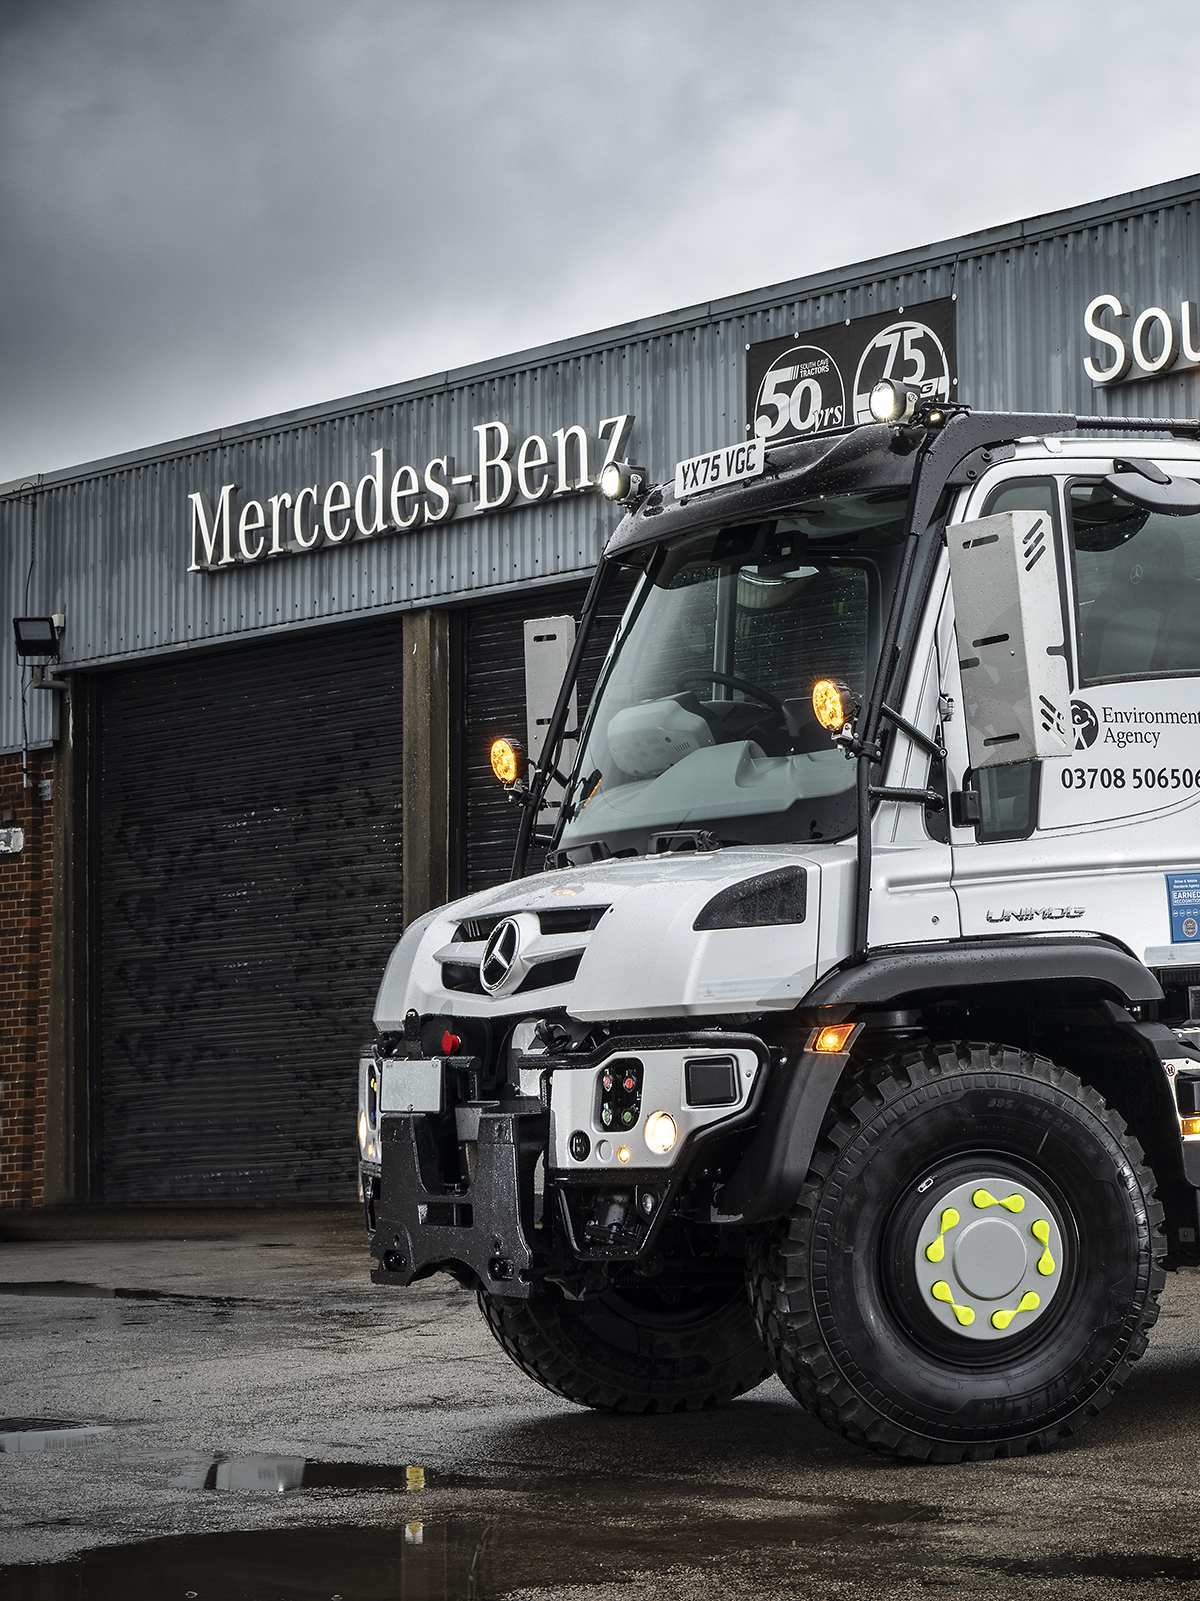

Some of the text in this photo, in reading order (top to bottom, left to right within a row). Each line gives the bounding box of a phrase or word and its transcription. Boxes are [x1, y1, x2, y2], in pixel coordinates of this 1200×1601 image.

[800, 357, 829, 370] SOUTH CAVE
[875, 328, 926, 385] 75
[800, 365, 830, 378] TRACTORS
[755, 366, 843, 438] 50 yrs
[682, 444, 756, 490] YX75 VGC
[187, 414, 633, 572] Mercedes-Benz
[1103, 727, 1161, 748] Agency
[1061, 768, 1126, 789] 03708
[986, 905, 1086, 923] UNIMOG
